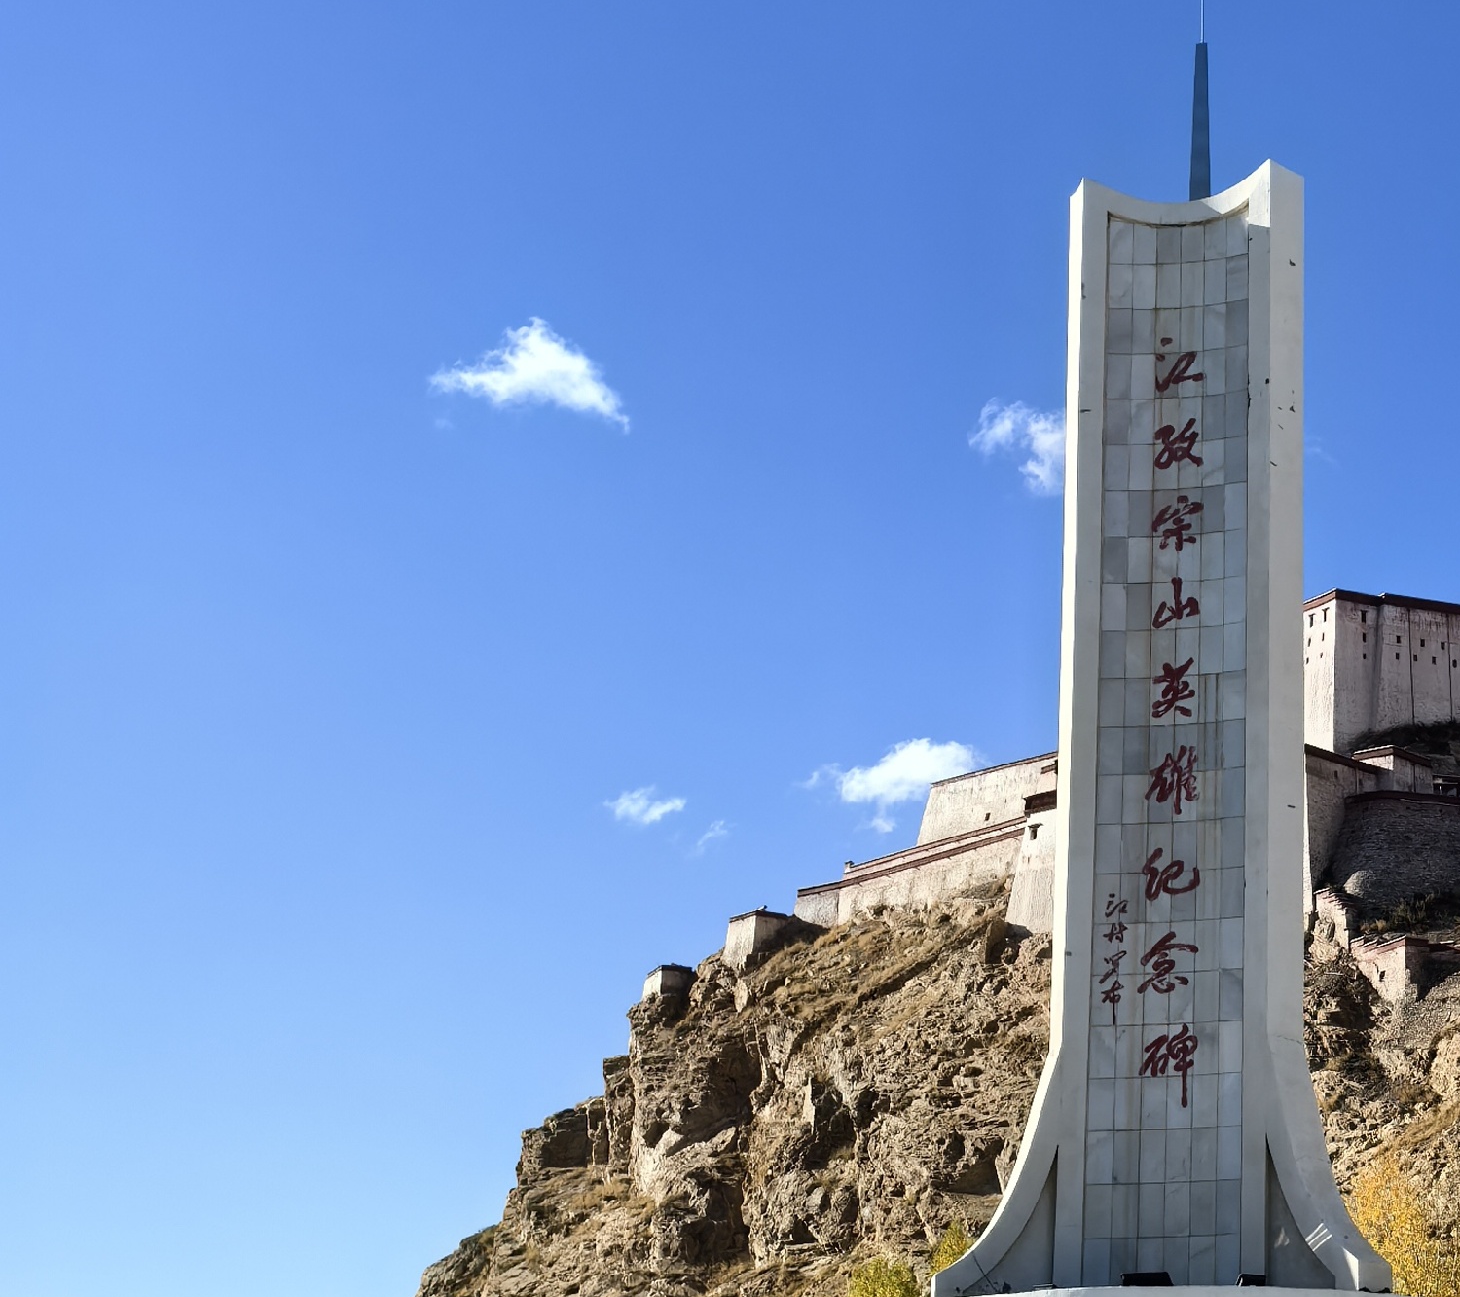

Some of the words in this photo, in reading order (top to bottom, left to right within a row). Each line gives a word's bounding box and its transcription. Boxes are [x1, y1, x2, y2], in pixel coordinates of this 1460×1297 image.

[1139, 337, 1204, 1108] 江孜宗山英雄纪念碑
